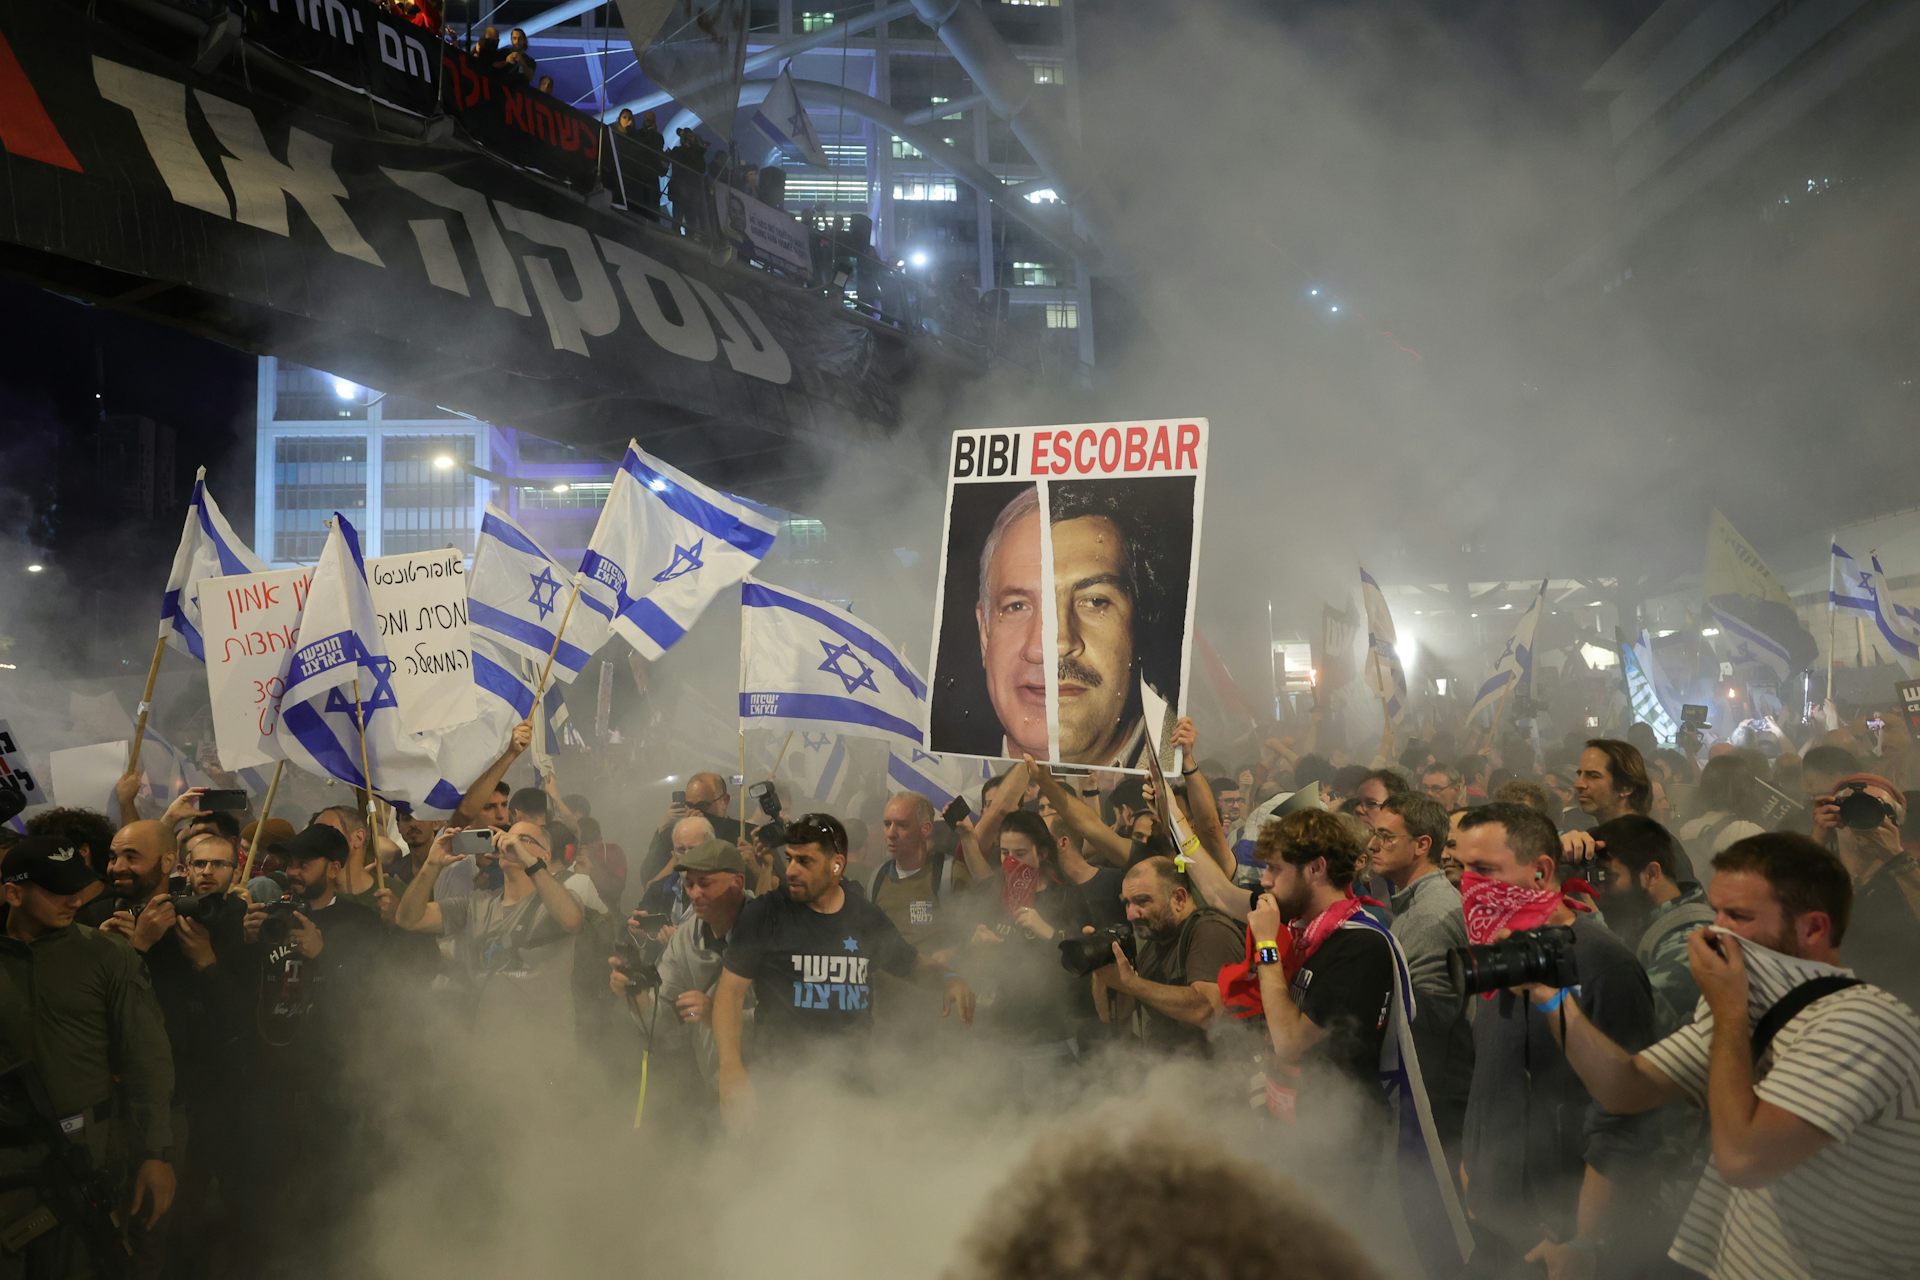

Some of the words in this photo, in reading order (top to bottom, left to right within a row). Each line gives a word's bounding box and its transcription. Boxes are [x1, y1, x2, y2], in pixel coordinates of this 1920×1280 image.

[377, 21, 431, 83] הם
[92, 55, 387, 268] או
[378, 165, 792, 385] עסקה
[953, 434, 1020, 477] BIBI
[1030, 424, 1200, 475] ESCOBAR
[227, 581, 280, 630] אמון
[416, 598, 467, 631] מסית
[298, 636, 342, 662] חופשי
[300, 649, 346, 677] בארצנו
[404, 642, 469, 676] הממשלה
[793, 981, 870, 1010] בארצנו
